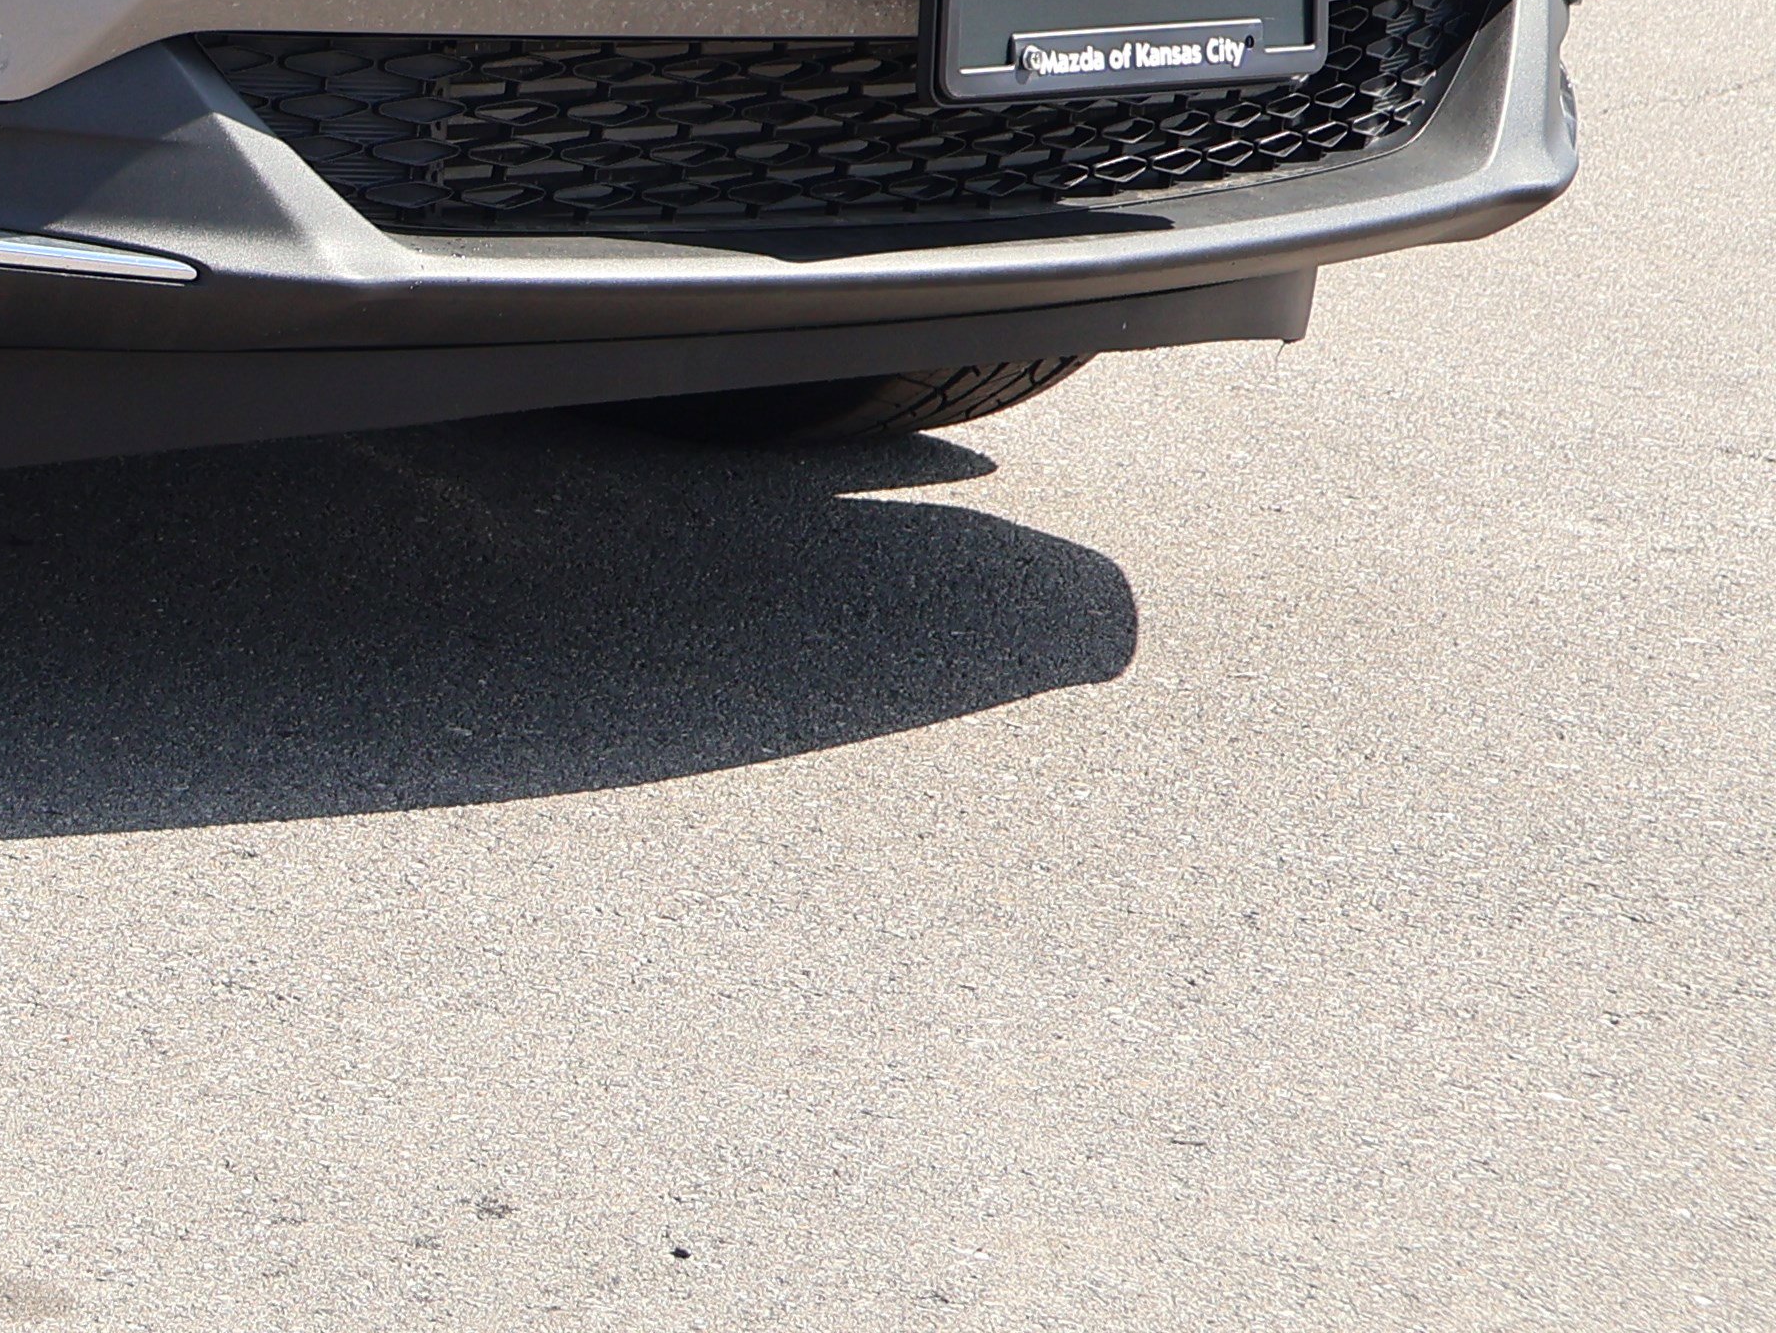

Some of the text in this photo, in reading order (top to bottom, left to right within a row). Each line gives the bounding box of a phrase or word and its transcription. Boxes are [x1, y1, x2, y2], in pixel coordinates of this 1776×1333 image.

[1040, 36, 1245, 76] Mazda of Kansas City
